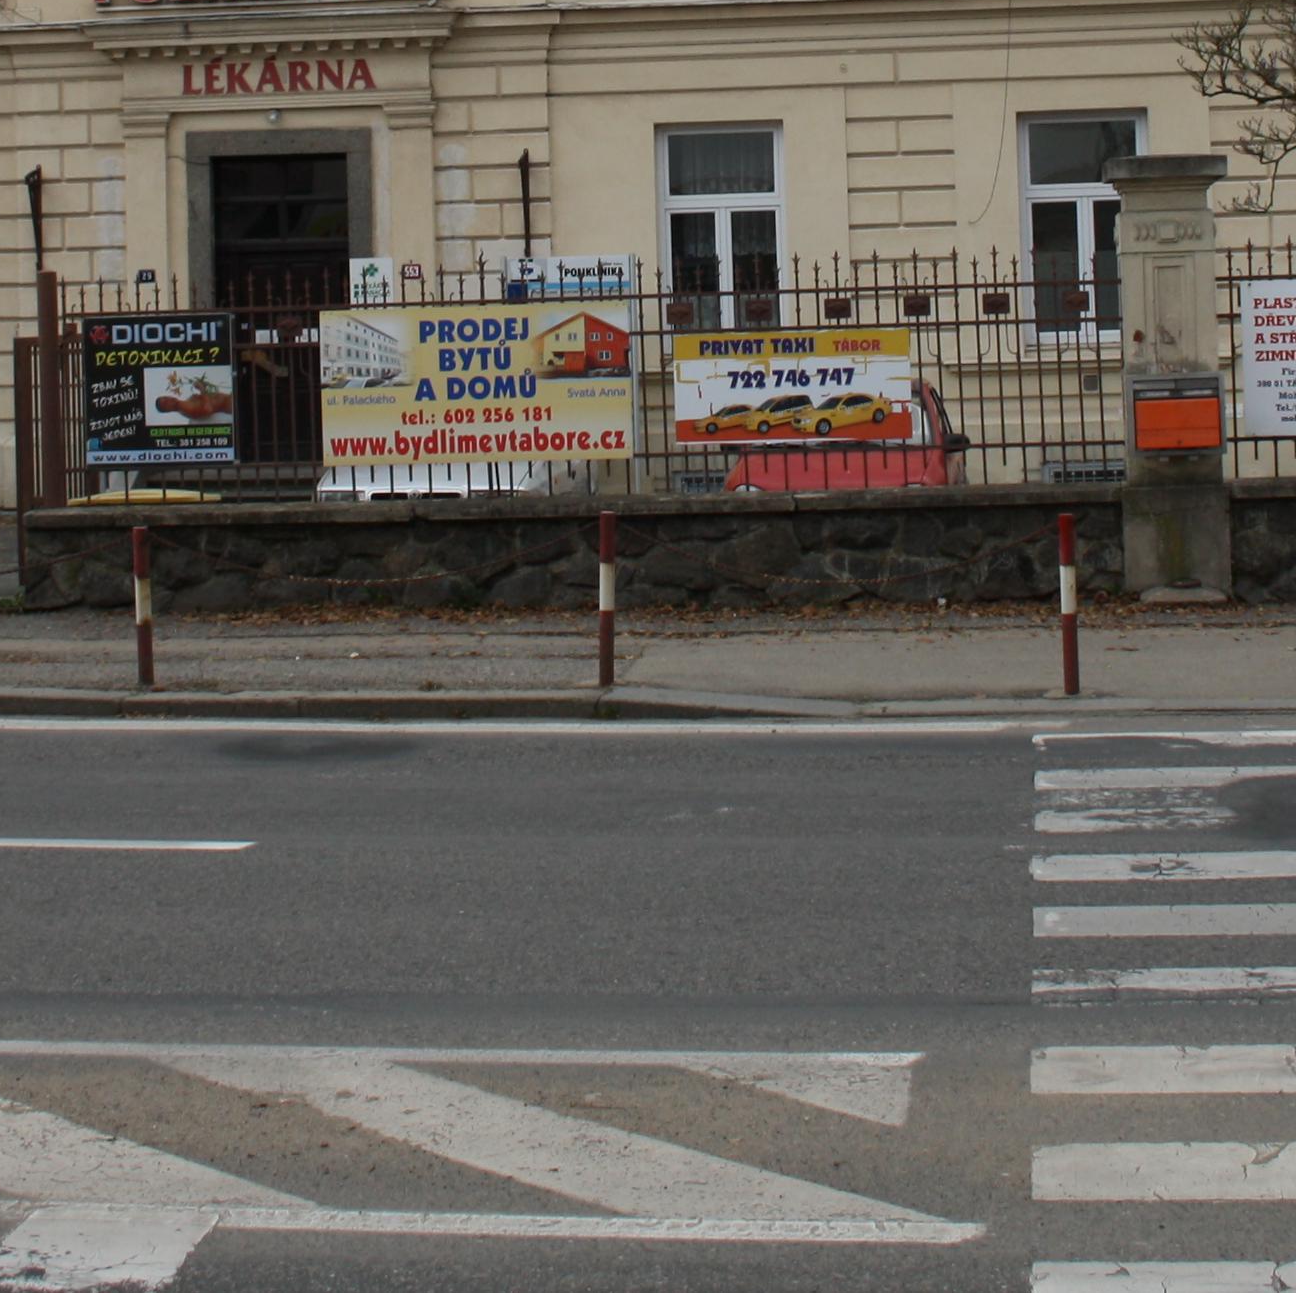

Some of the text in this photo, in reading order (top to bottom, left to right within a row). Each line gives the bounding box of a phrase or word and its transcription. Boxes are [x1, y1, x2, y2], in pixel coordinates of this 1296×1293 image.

[182, 57, 377, 96] LÉKÁRNA
[141, 271, 152, 281] 29
[112, 321, 217, 344] DIOCHI
[419, 317, 529, 343] PRODEJ
[1254, 333, 1265, 344] A
[438, 340, 511, 372] BYTŮ
[699, 337, 881, 355] PRIVAT TAXI TÁBOR
[414, 368, 537, 401] A DOMŮ
[727, 367, 855, 389] 722 746 747
[327, 392, 396, 406] ul. Palackého
[567, 385, 626, 399] Svatá Anna
[401, 406, 552, 425] tel.: 602 256 181
[331, 427, 625, 459] www.bydlimevtabore.cz
[93, 451, 229, 462] www.diochi.com
